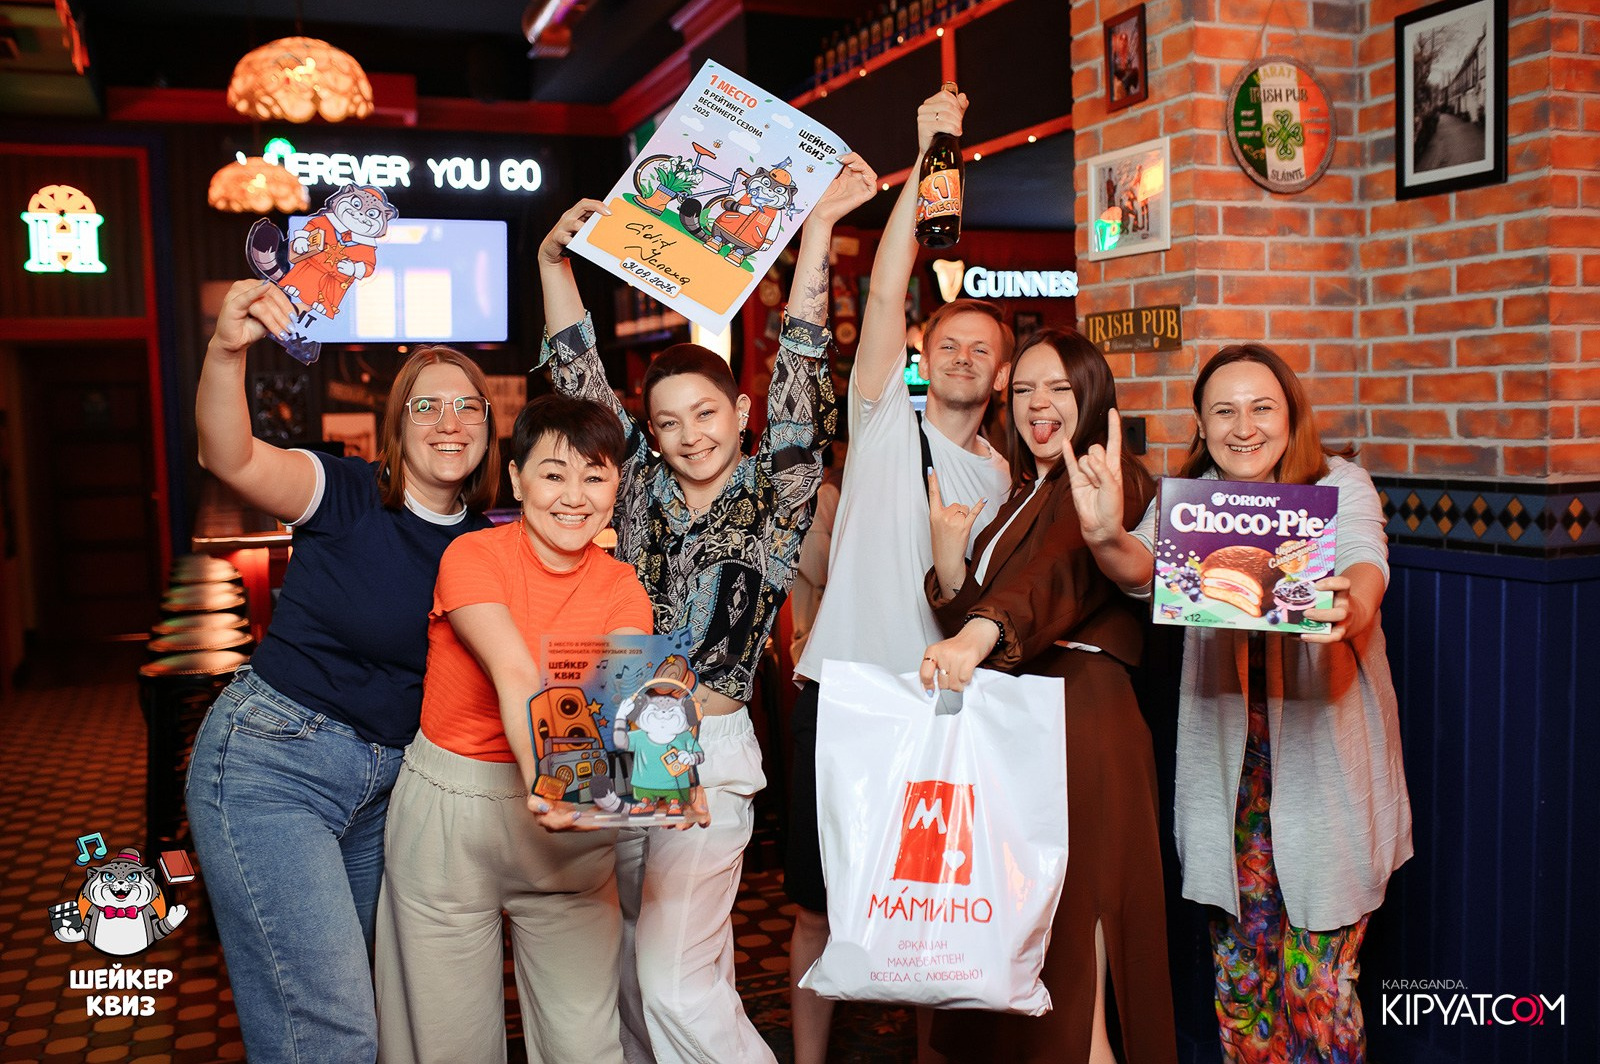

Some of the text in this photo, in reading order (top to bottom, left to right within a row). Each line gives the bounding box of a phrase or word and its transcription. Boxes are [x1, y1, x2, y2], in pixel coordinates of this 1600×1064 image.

[703, 88, 745, 116] В РЕЙТИНГЕ
[709, 74, 758, 109] 1 МЕСТО
[1249, 87, 1309, 102] IRISH PUB
[692, 104, 710, 118] 2025
[698, 96, 763, 138] ВЕСЕННЕГО СЕЗОНА
[798, 129, 837, 156] ШЕЙКЕР
[798, 141, 826, 161] КВИЗ
[426, 156, 491, 191] YOU
[500, 158, 542, 192] GO
[932, 175, 951, 200] 1
[1088, 308, 1179, 344] IRISH PUB
[1228, 494, 1278, 507] ORION
[548, 659, 589, 670] ШЕЙКЕР
[554, 672, 581, 680] КВИЗ
[870, 970, 912, 983] ВСЕГДА
